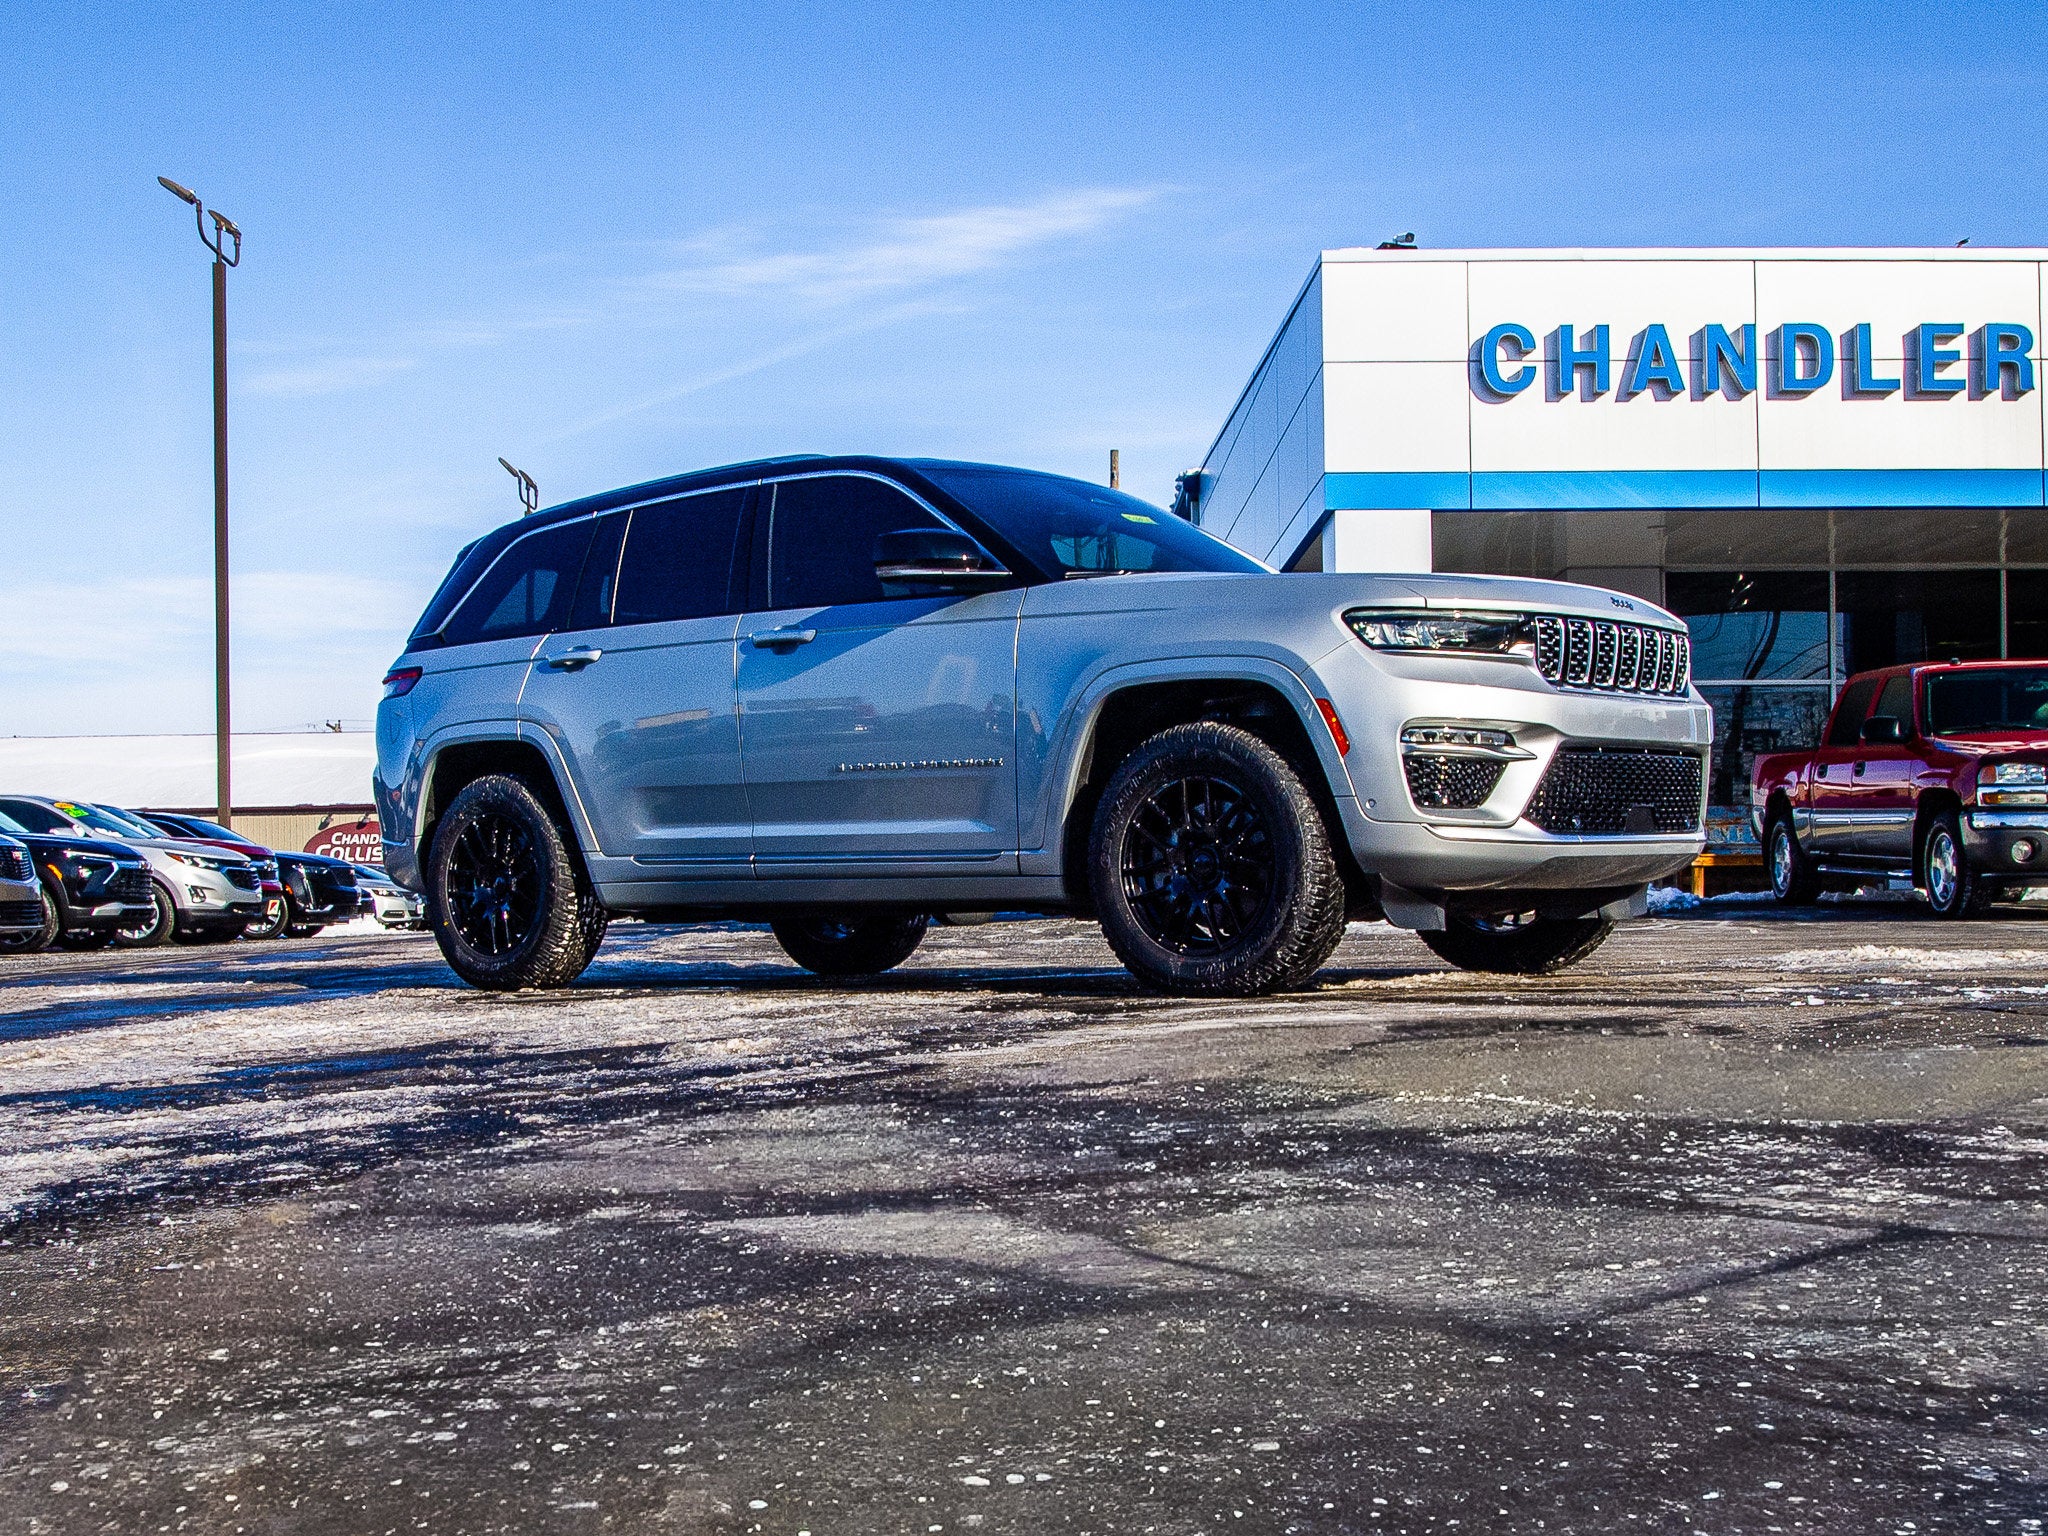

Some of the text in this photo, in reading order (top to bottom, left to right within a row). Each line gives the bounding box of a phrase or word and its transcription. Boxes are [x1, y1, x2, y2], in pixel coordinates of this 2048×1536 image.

[1478, 322, 2035, 395] CHANDLER
[331, 831, 382, 845] CHAND
[315, 844, 383, 862] COLLIS
